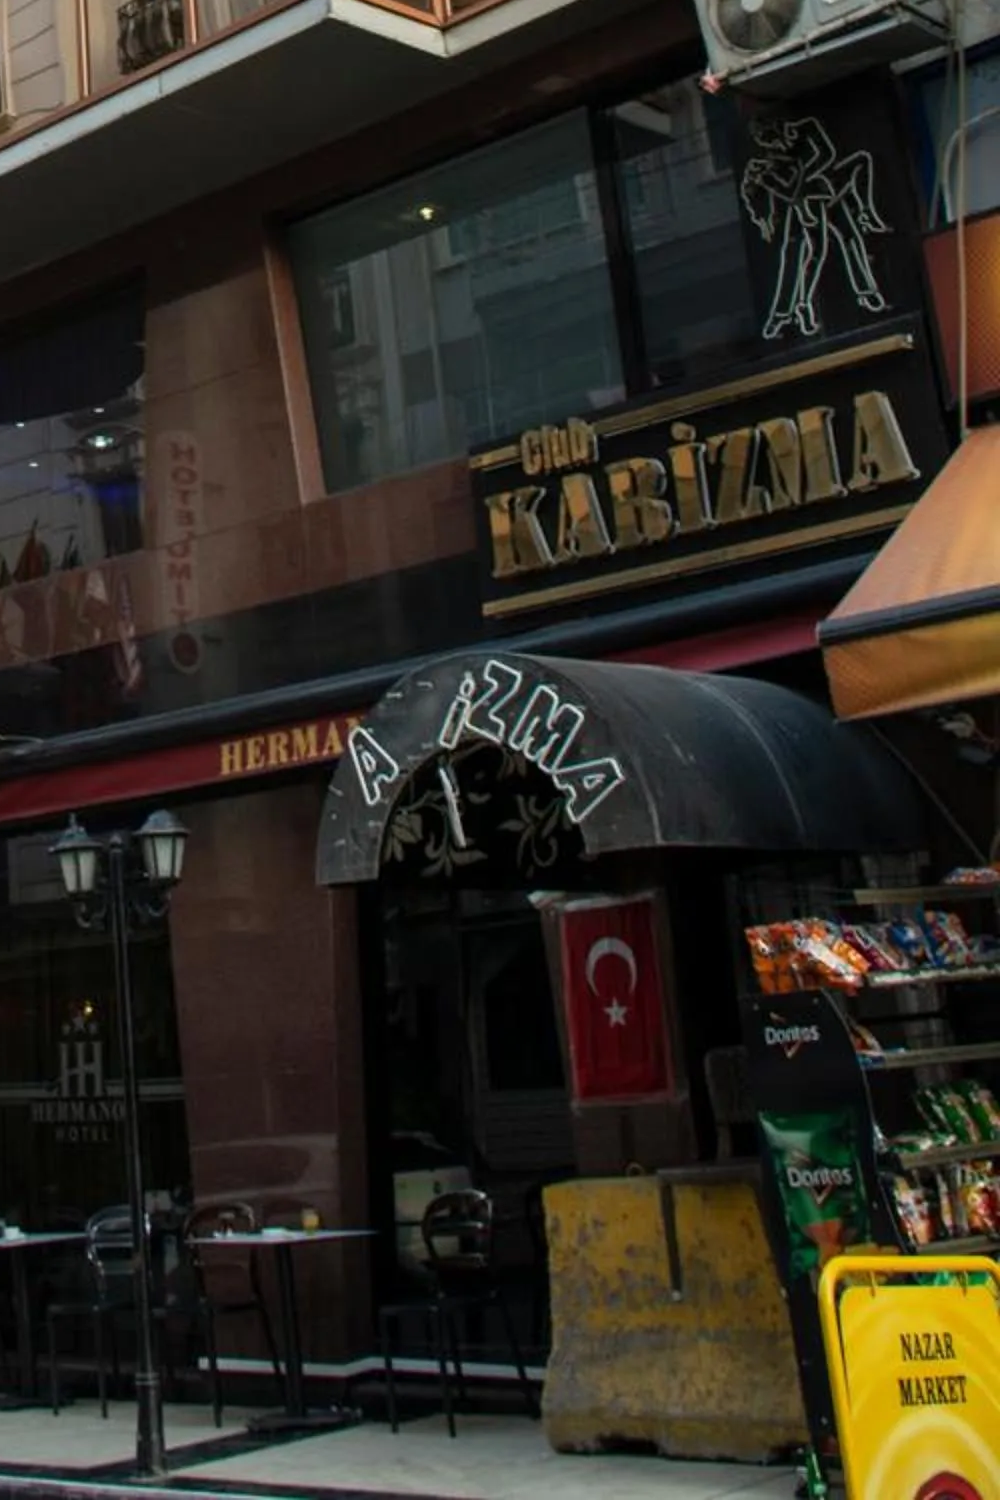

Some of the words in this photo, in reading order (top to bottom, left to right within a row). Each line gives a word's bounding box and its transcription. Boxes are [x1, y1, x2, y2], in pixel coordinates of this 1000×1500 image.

[764, 1024, 820, 1046] Doritos
[786, 1166, 853, 1189] Doritos
[900, 1332, 956, 1361] NAZAR
[898, 1375, 967, 1407] MARKET
